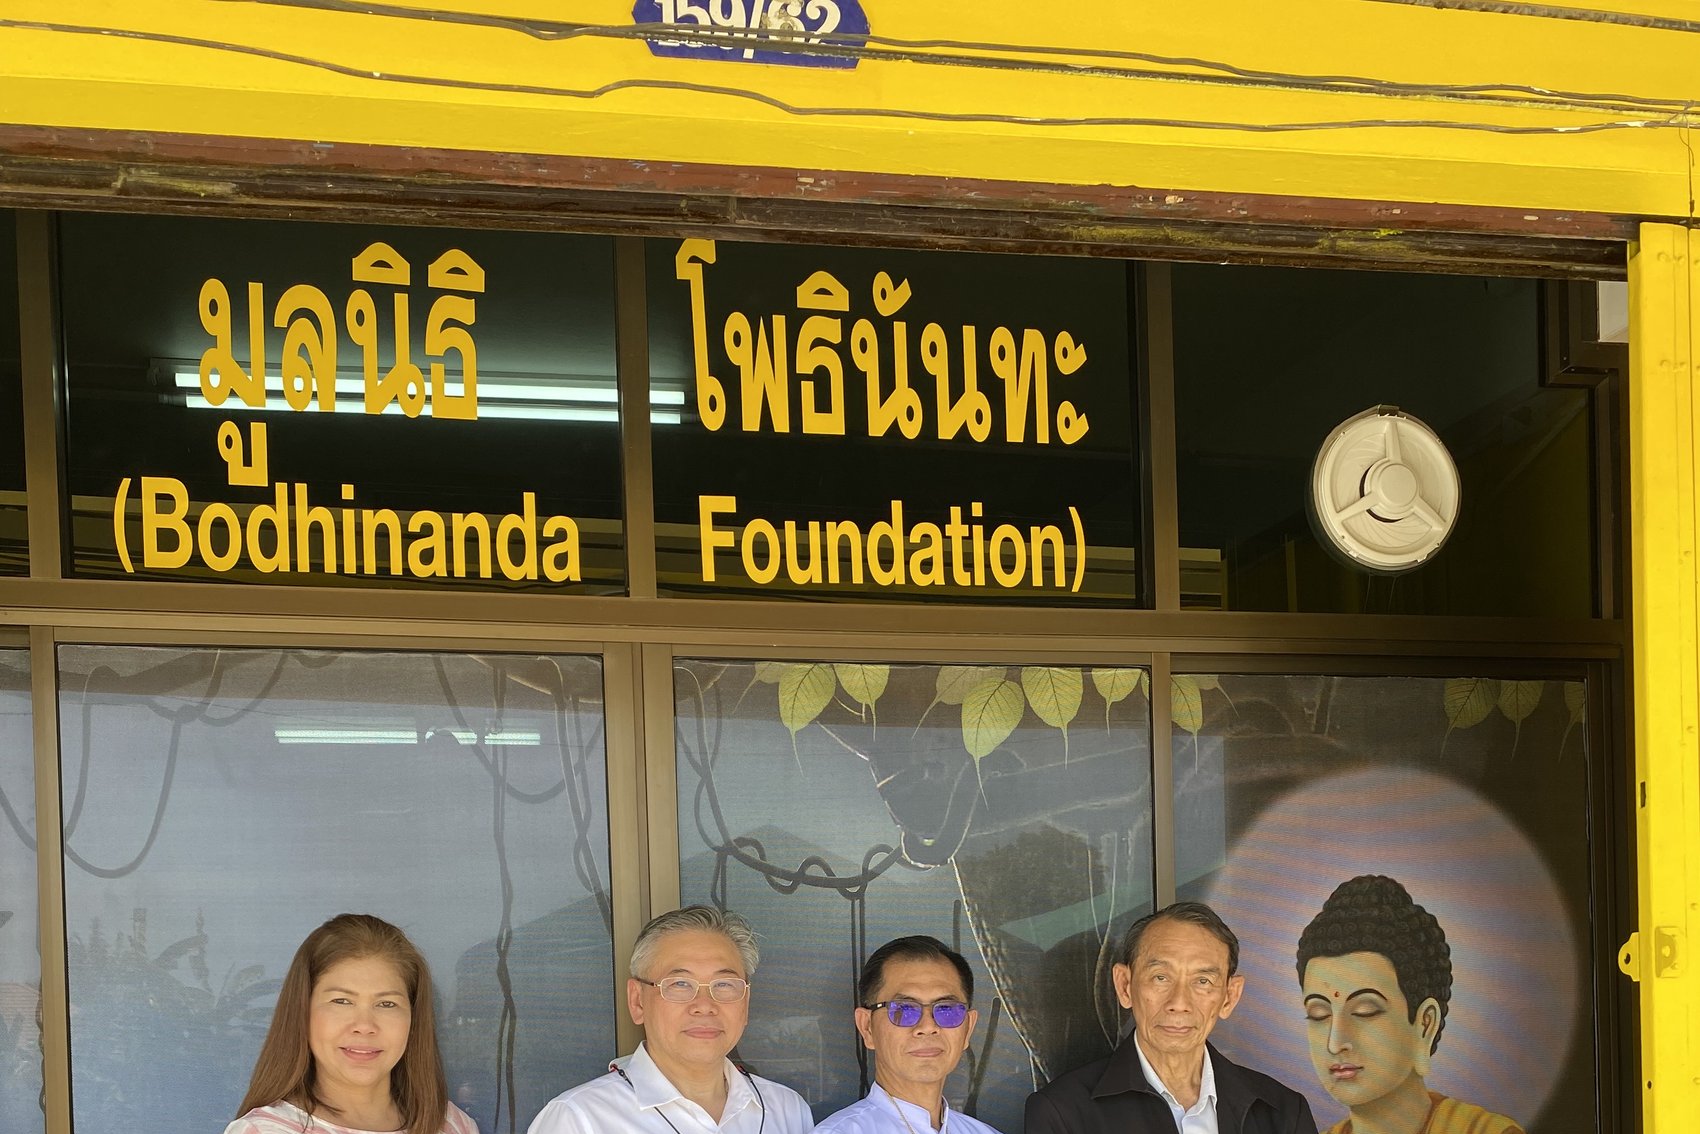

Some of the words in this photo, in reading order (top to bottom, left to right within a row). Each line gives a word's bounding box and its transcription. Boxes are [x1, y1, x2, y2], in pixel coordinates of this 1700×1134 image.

[655, 0, 846, 59] 159/62
[198, 242, 485, 487] มูลนิธิ
[675, 238, 1089, 445] โพธินันทะ
[113, 476, 582, 582] (Bodhinanda
[699, 495, 1086, 593] Foundation)
